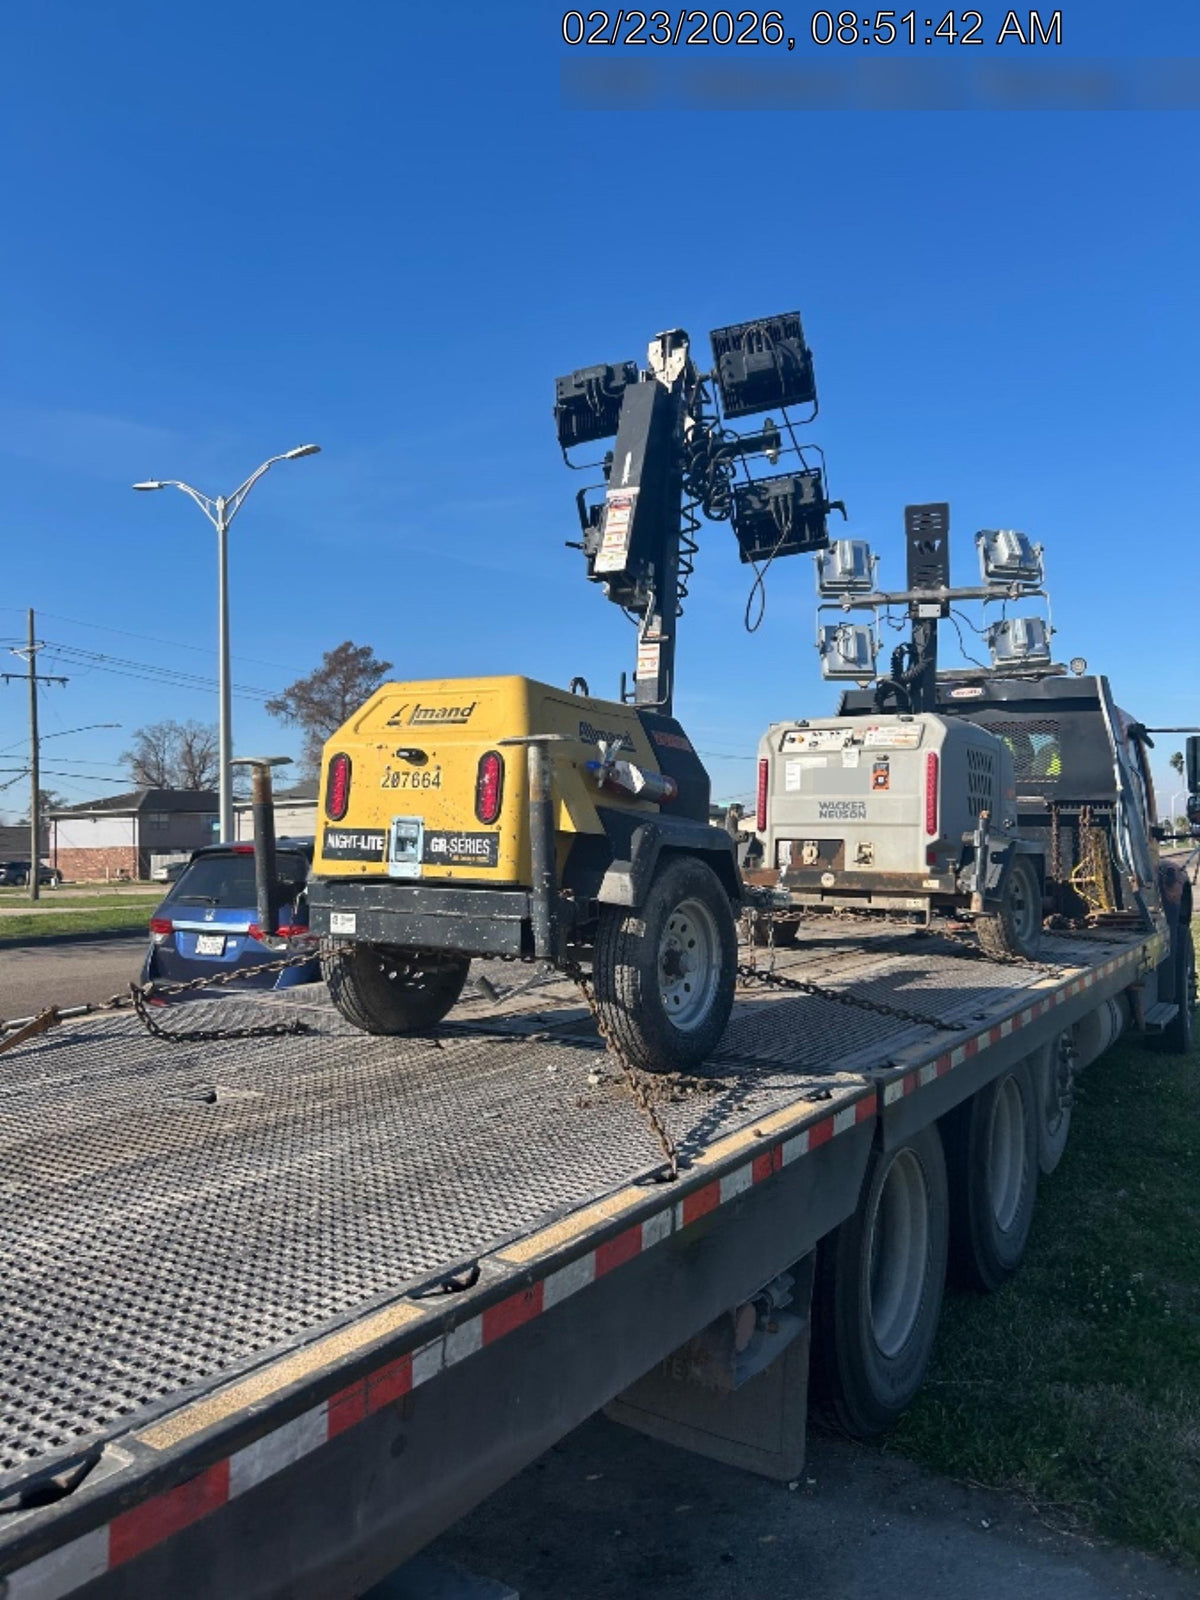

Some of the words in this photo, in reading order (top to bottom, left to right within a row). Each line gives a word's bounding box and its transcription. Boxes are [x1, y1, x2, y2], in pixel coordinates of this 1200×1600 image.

[381, 771, 441, 789] 207664
[818, 801, 866, 811] WACKER
[818, 810, 867, 819] NEUSON
[327, 833, 384, 851] NIGHT-LITE
[430, 837, 491, 856] GR-SERIES
